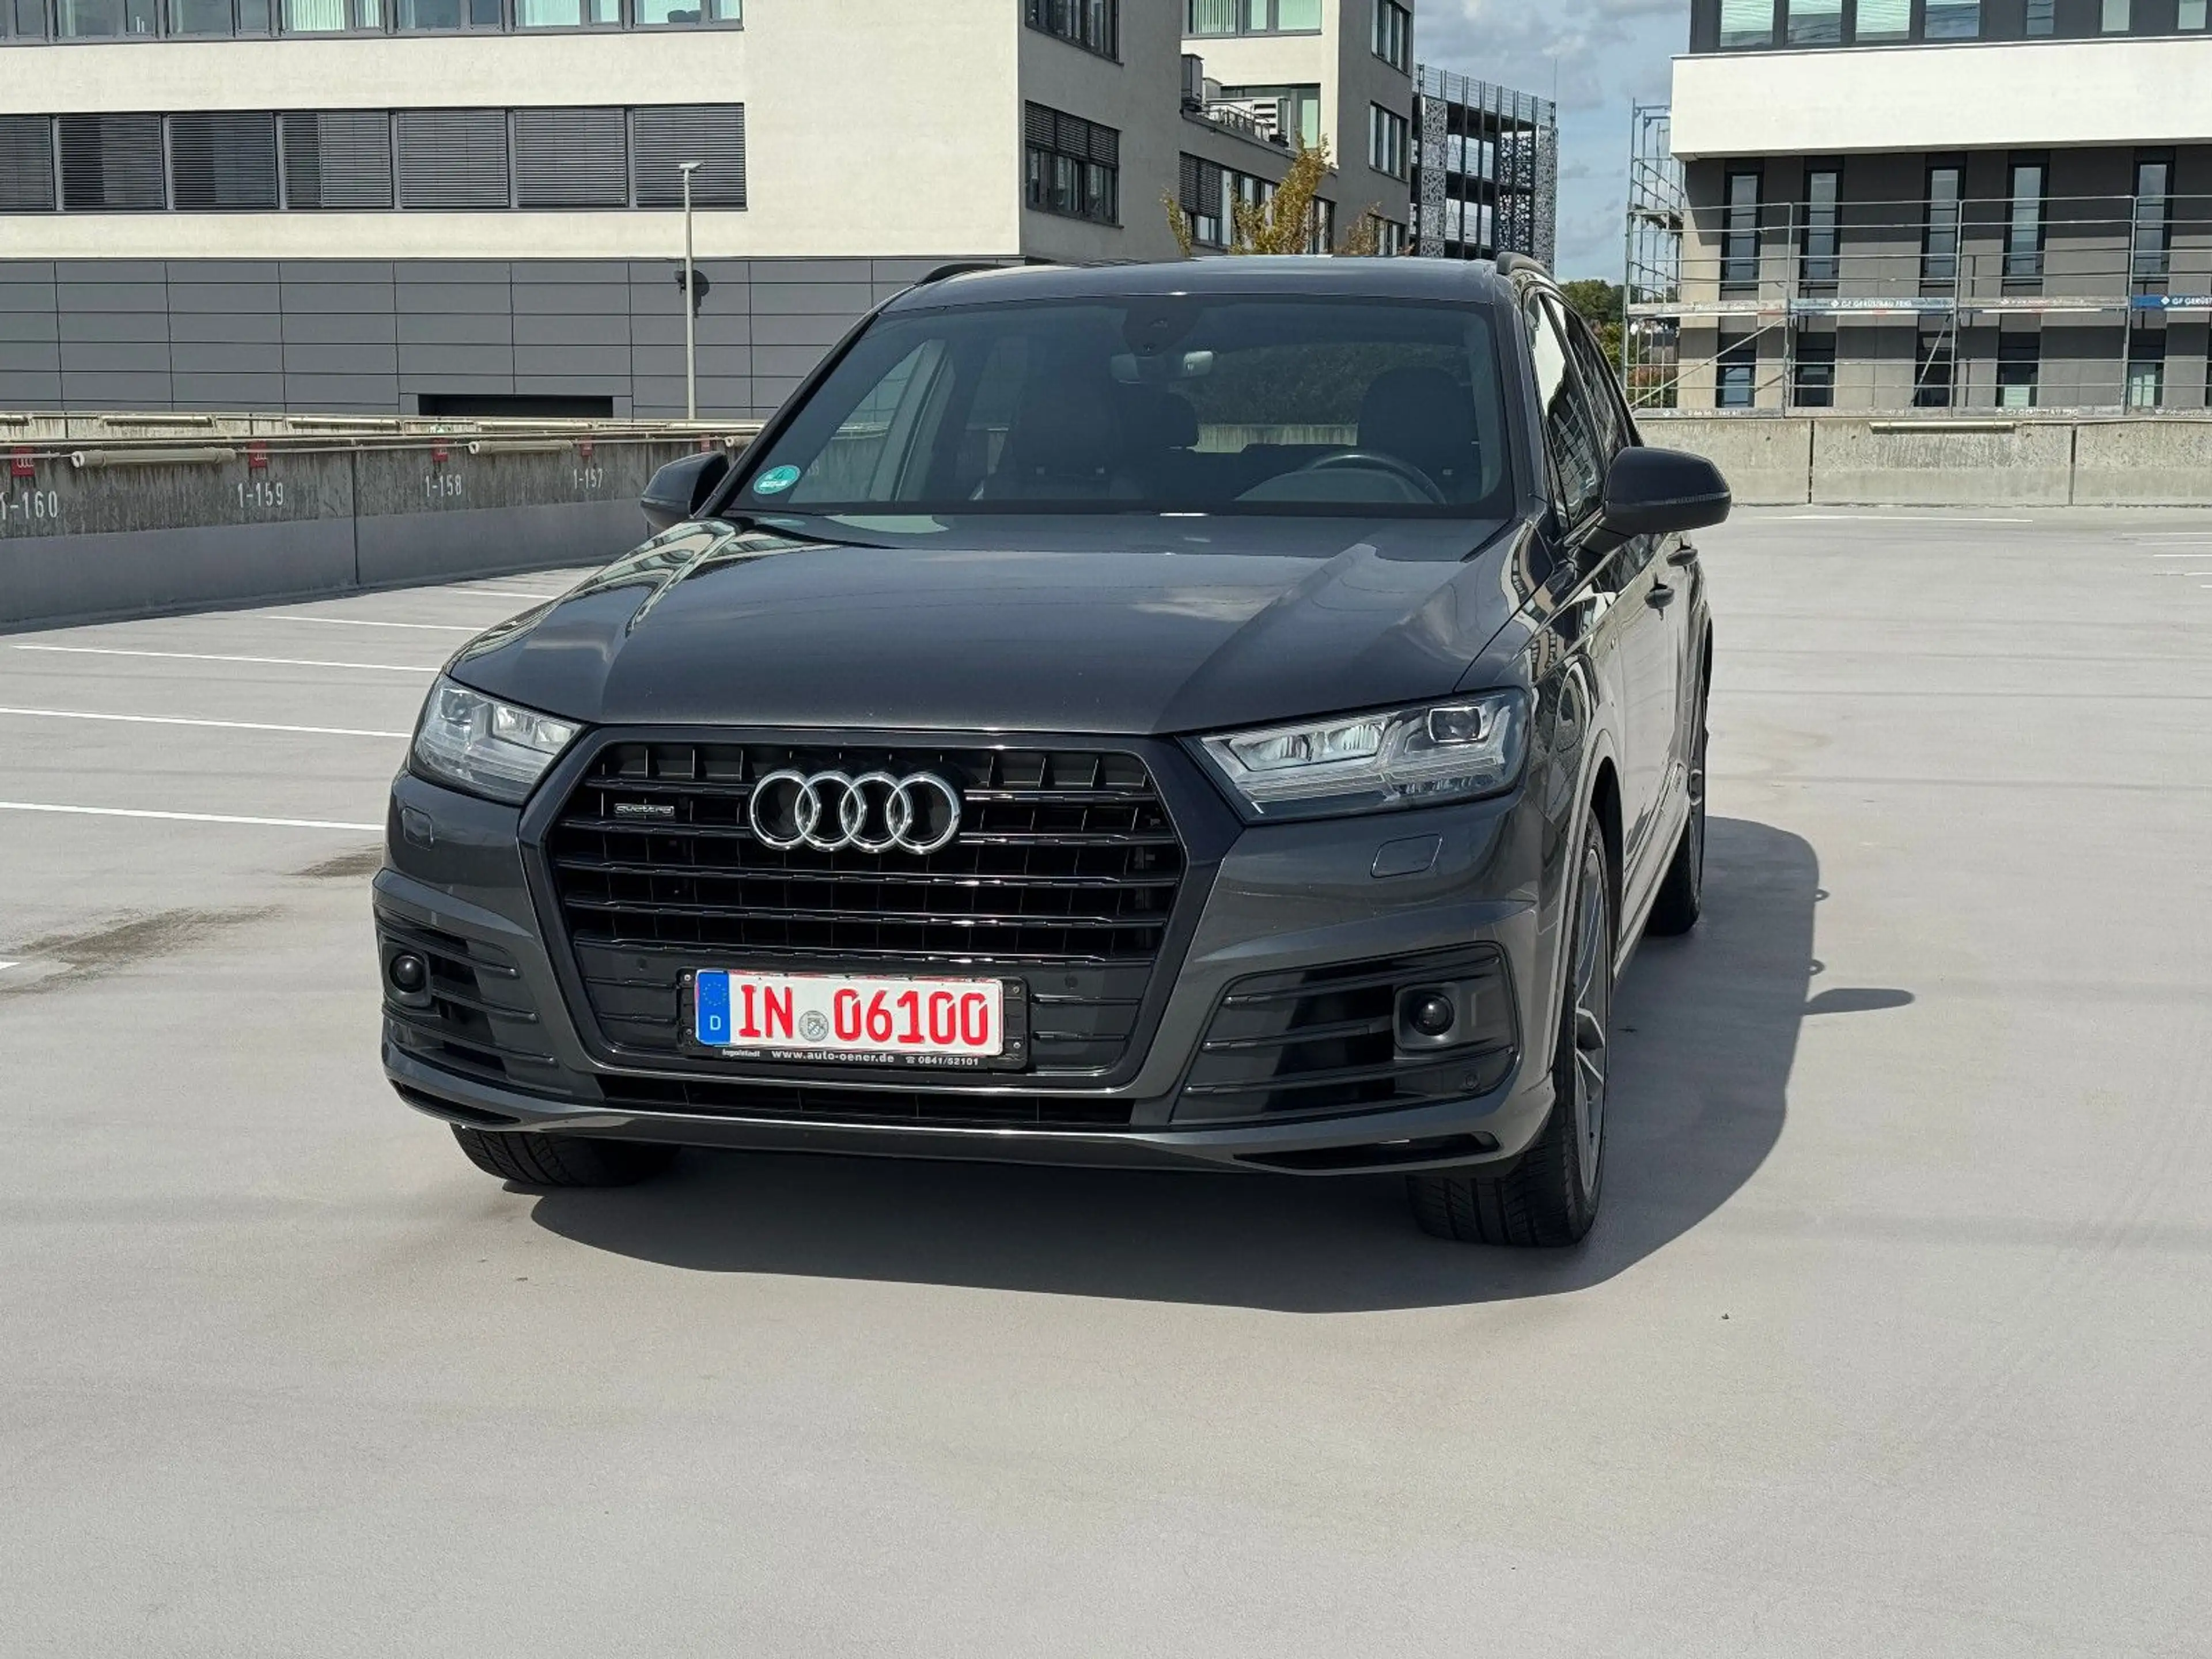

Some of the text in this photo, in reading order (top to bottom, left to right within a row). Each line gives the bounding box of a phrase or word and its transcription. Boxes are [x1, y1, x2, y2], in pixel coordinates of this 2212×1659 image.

[426, 474, 461, 497] 1-158
[574, 468, 603, 489] 1-157
[0, 491, 58, 520] 1-160
[237, 482, 283, 507] 1-159
[710, 1014, 721, 1031] D
[738, 984, 988, 1046] IN 06100
[771, 1050, 894, 1063] www.auto-oener.de
